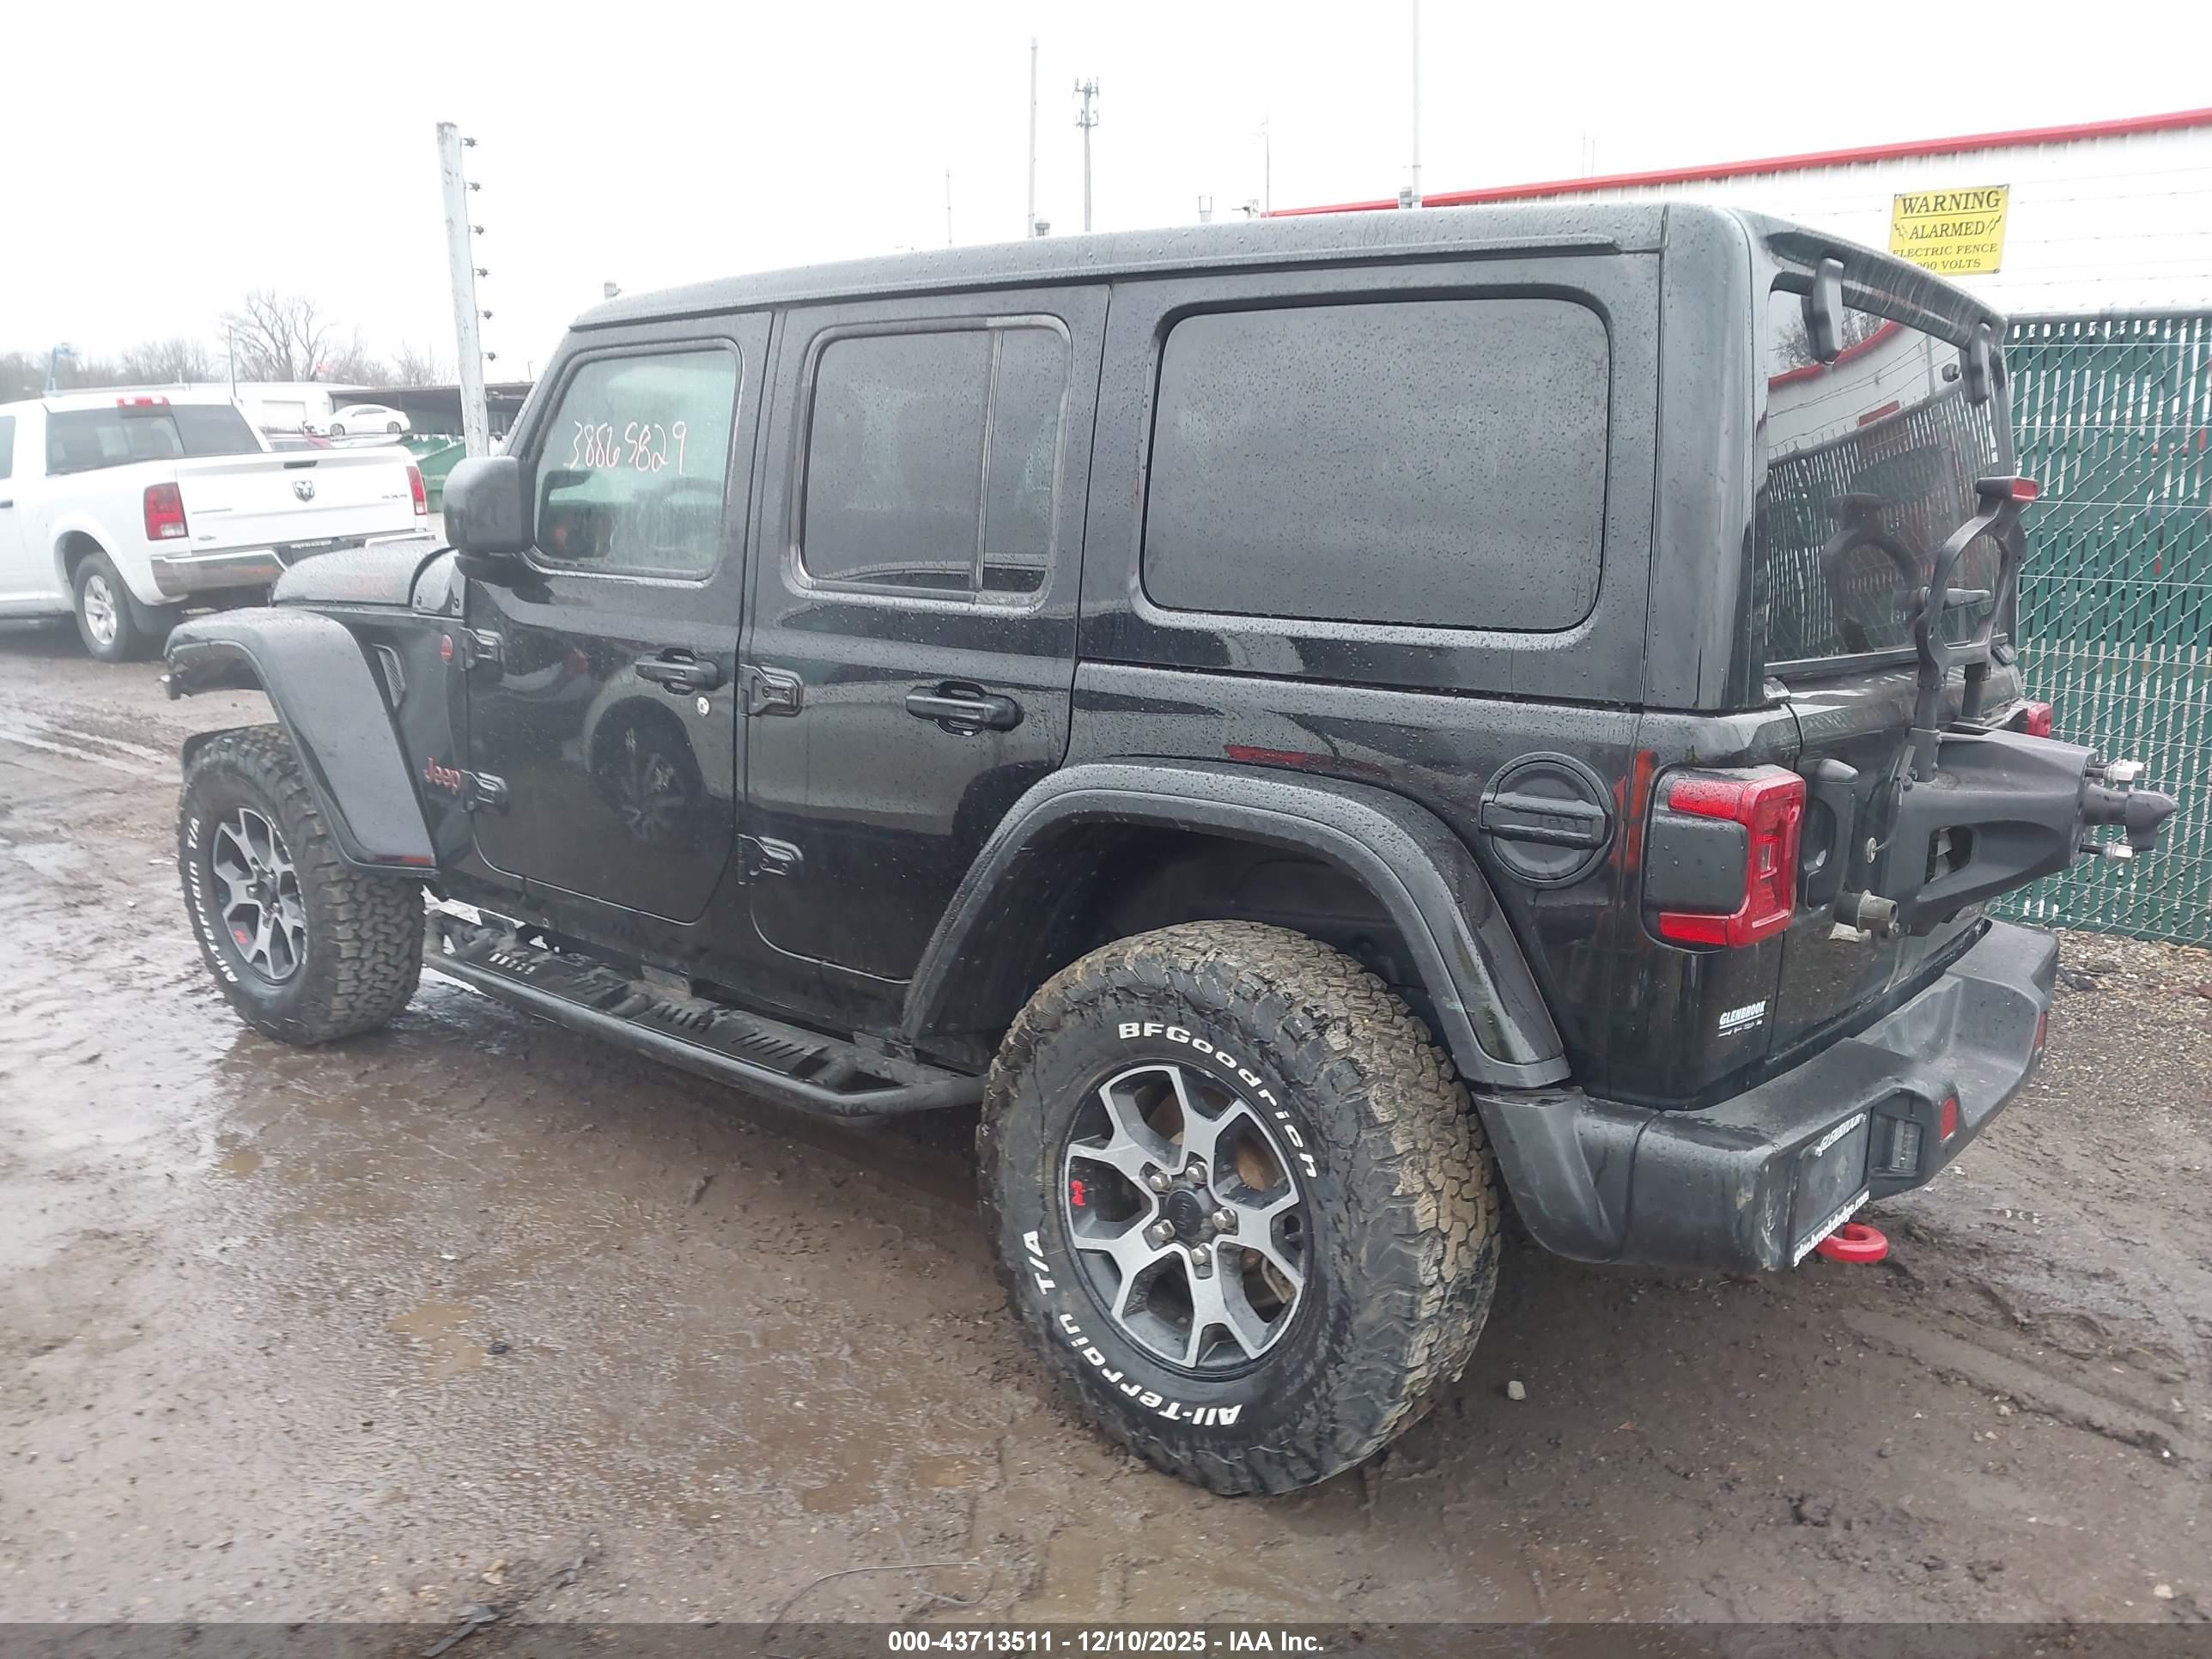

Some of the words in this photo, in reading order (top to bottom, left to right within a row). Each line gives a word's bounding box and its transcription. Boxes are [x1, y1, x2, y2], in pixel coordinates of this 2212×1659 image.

[1902, 191, 2001, 215] WARNING
[1909, 220, 1985, 240] ALARMED
[1956, 243, 1998, 255] FENCE
[1942, 258, 1981, 270] VOLTS
[422, 756, 461, 797] Jeep
[186, 817, 201, 849] T/A
[1719, 1000, 1766, 1025] GLENBROOK
[1118, 1022, 1317, 1178] BFGoodrich
[1023, 1231, 1057, 1296] T/A
[1058, 1314, 1243, 1426] All-Terrain
